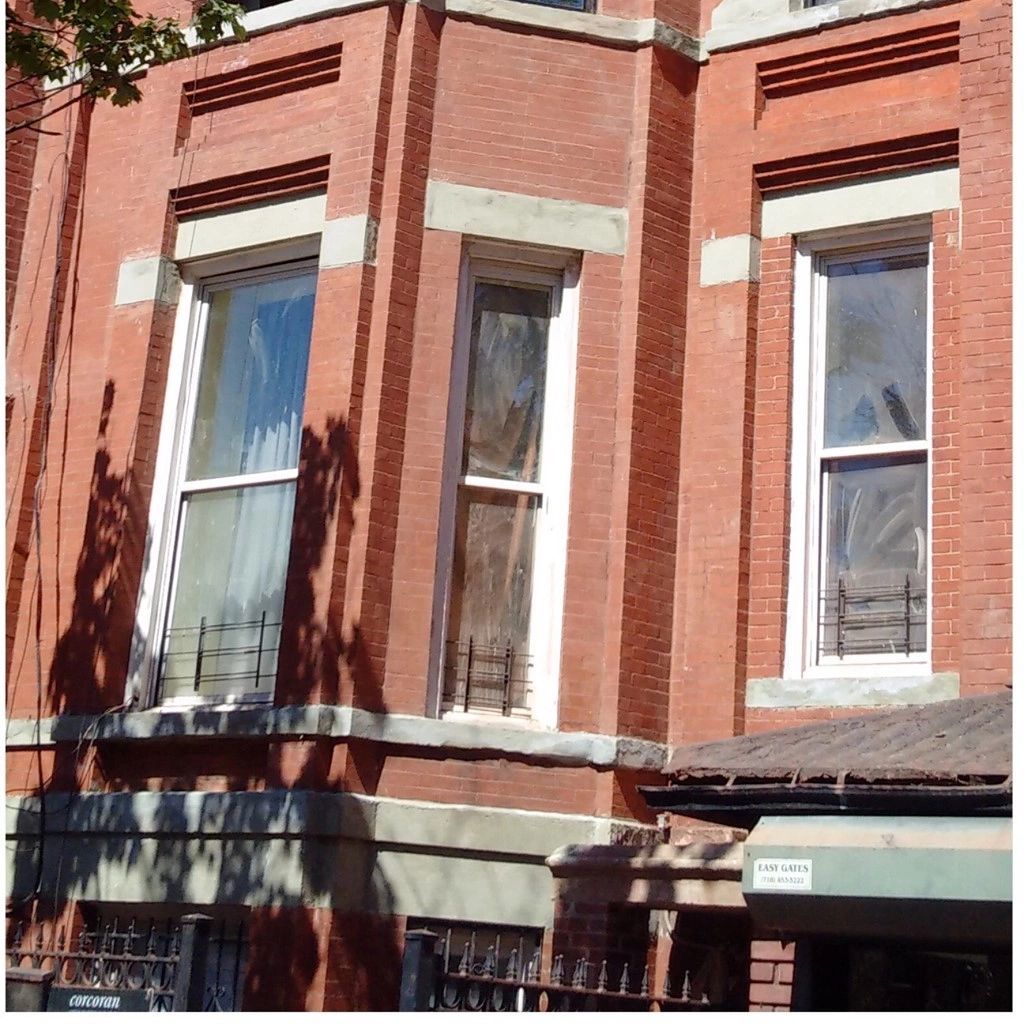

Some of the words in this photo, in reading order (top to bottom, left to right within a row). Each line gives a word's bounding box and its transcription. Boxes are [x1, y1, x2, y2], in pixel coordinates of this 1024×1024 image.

[758, 863, 778, 872] EASY
[781, 863, 809, 874] GATES
[69, 994, 121, 1010] corcoran
